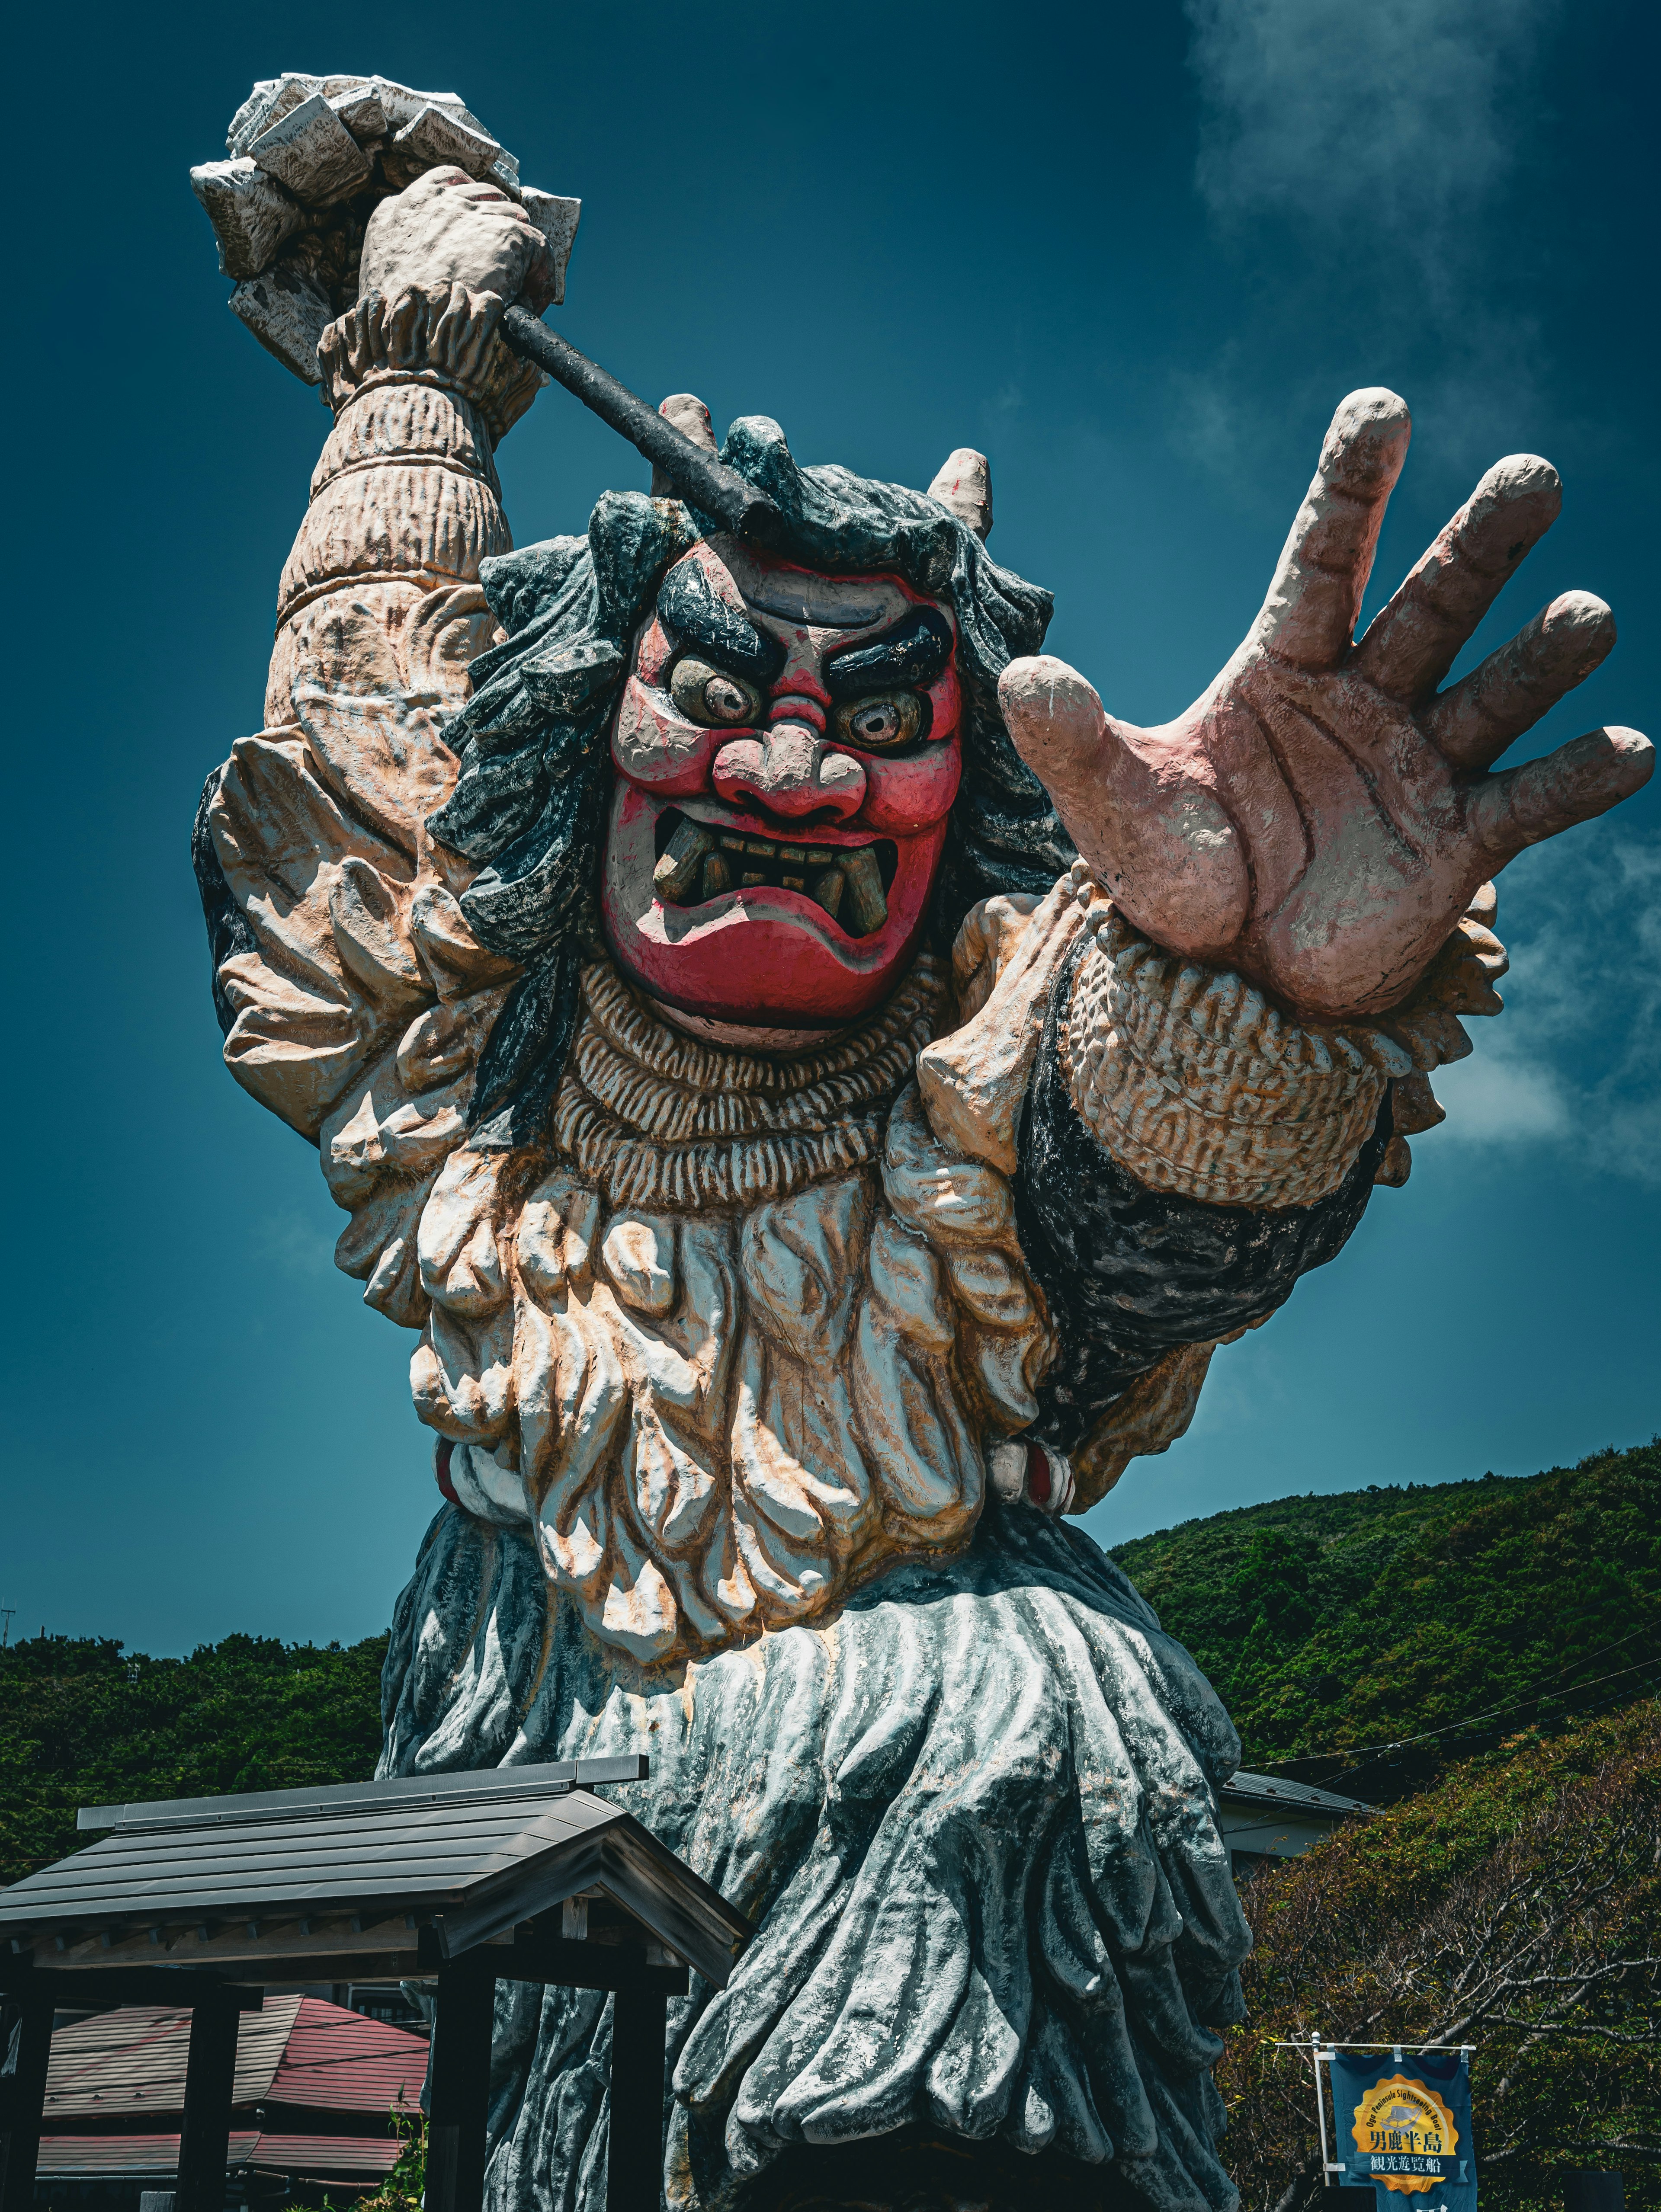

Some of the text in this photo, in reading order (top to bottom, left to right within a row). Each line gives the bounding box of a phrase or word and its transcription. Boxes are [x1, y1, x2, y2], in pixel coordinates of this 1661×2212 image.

[1366, 2089, 1442, 2131] Oga Peninsula Sightseeing Boat
[1370, 2130, 1442, 2153] 男鹿半島
[1370, 2155, 1441, 2173] 観光遊覧船
